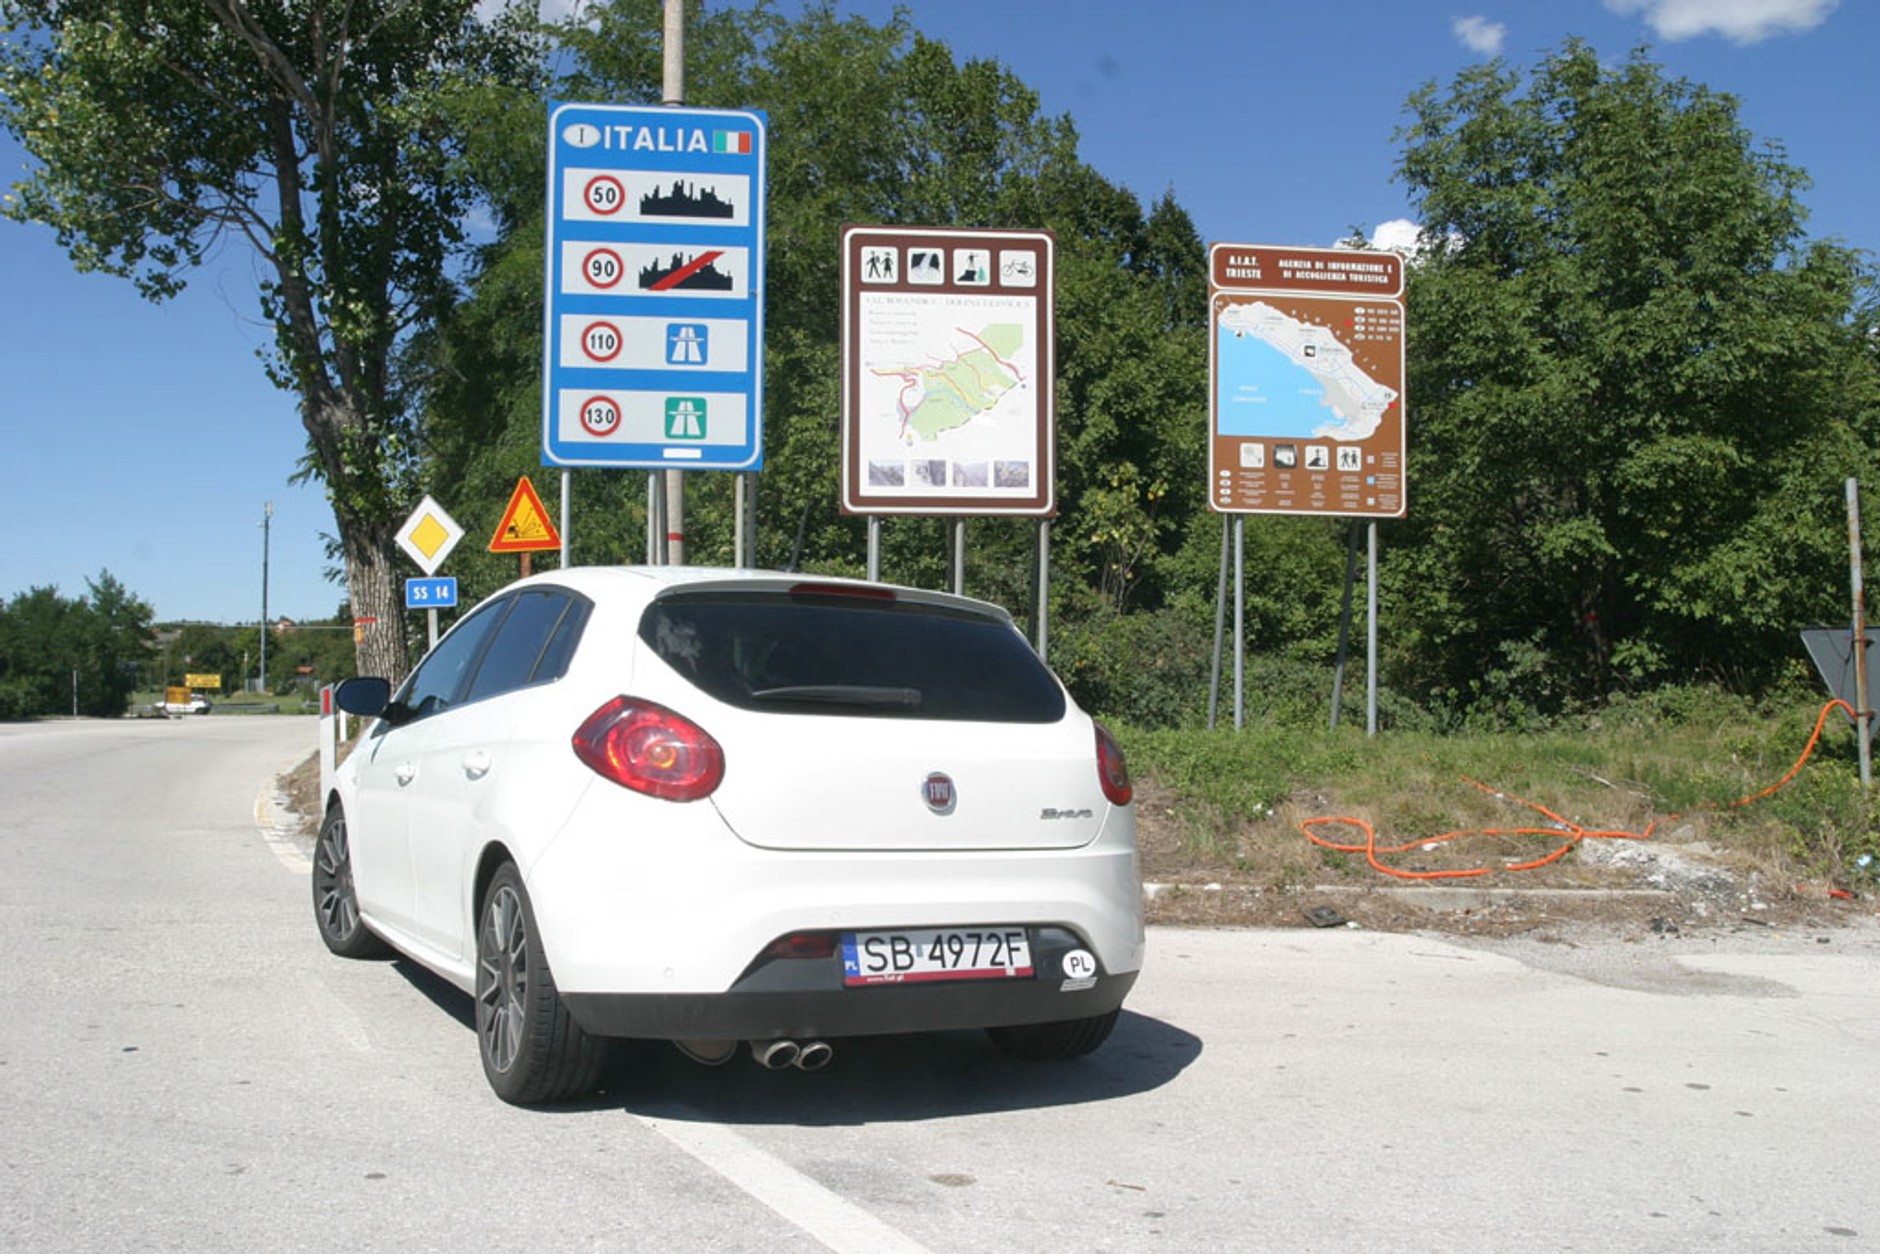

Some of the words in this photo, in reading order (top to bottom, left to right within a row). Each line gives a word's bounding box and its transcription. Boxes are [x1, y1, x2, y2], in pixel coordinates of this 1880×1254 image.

[603, 125, 708, 153] ITALIA
[592, 186, 617, 205] 50
[591, 259, 615, 278] 90
[1226, 268, 1262, 279] TRIESTE
[1278, 259, 1312, 269] AGENZIA
[1315, 260, 1324, 270] DI
[1327, 261, 1384, 273] INFORMAZIONE
[1283, 270, 1292, 279] DI
[1296, 270, 1346, 281] ACCOGLIENZA
[1349, 273, 1389, 284] TURISTICA
[590, 333, 615, 351] 110
[586, 408, 615, 424] 130
[413, 586, 428, 600] SS
[435, 585, 449, 600] 14
[864, 936, 915, 972] SB
[928, 931, 1022, 969] 4972F
[844, 960, 858, 971] PL
[1070, 956, 1091, 973] PL
